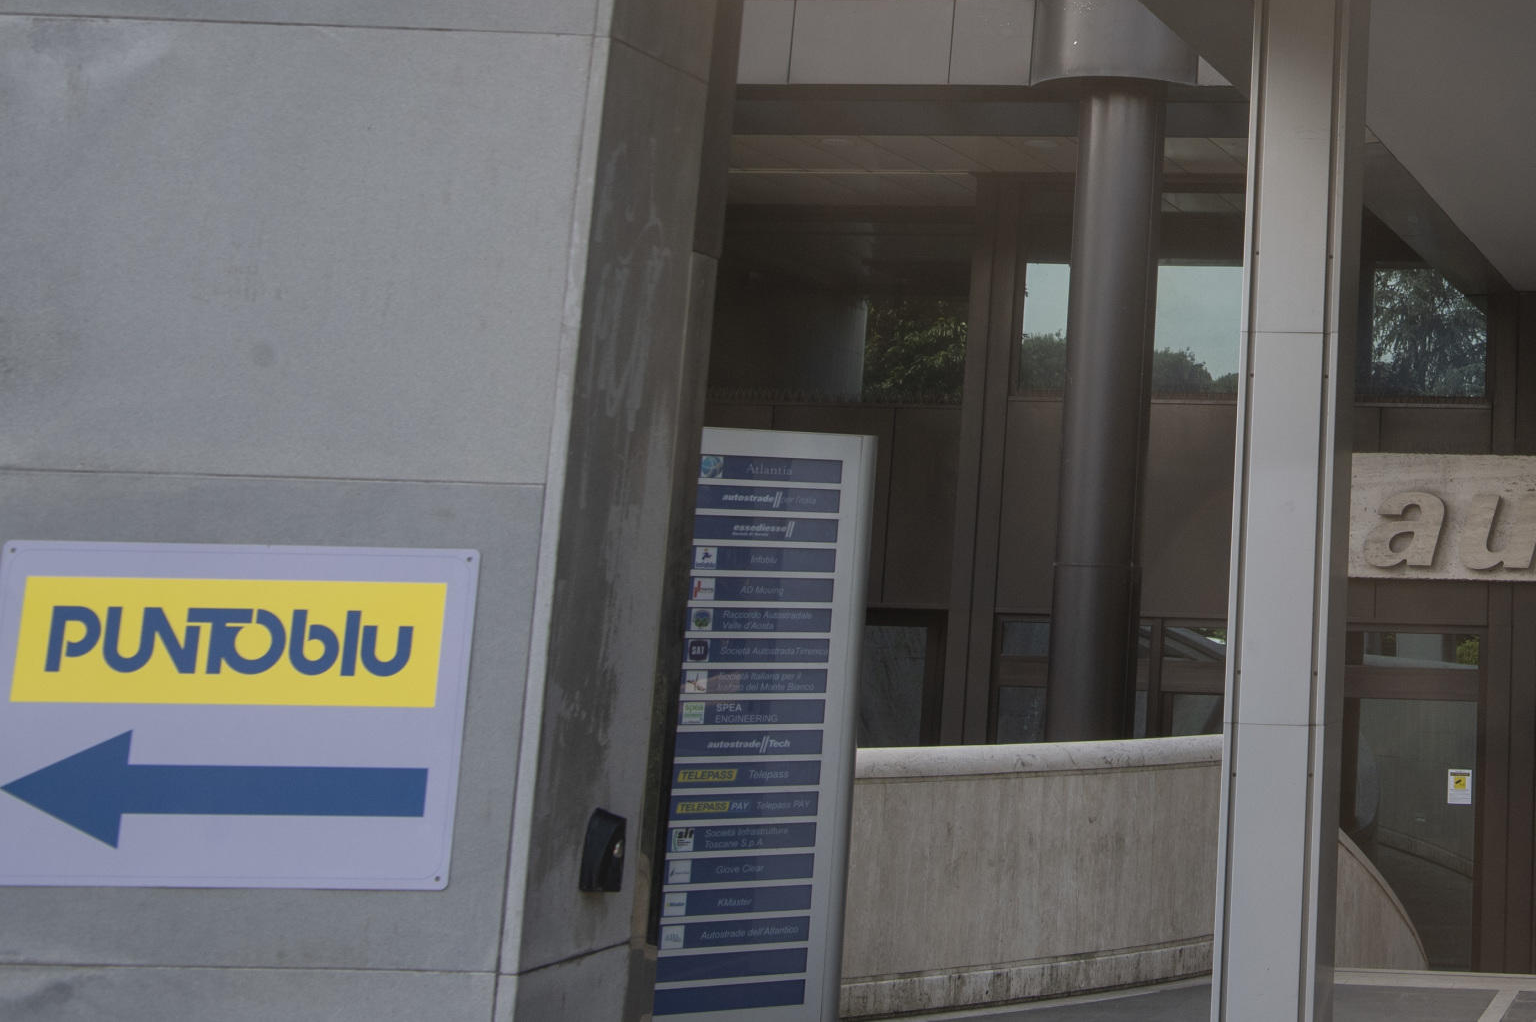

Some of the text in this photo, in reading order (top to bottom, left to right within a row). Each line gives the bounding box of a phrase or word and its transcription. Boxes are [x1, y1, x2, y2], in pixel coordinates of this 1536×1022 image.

[746, 463, 793, 476] Atlantia
[722, 493, 774, 503] autostrade
[755, 585, 785, 596] Moving
[722, 611, 761, 620] Raccordo
[691, 645, 705, 655] SAT
[716, 704, 742, 712] SPEA
[715, 714, 778, 723] ENGINEERING
[707, 738, 791, 749] autostrade Tech
[681, 770, 733, 781] TELEPASS
[749, 769, 790, 780] Telepass
[680, 801, 750, 812] TELEPASS PAY
[793, 800, 811, 809] PAY
